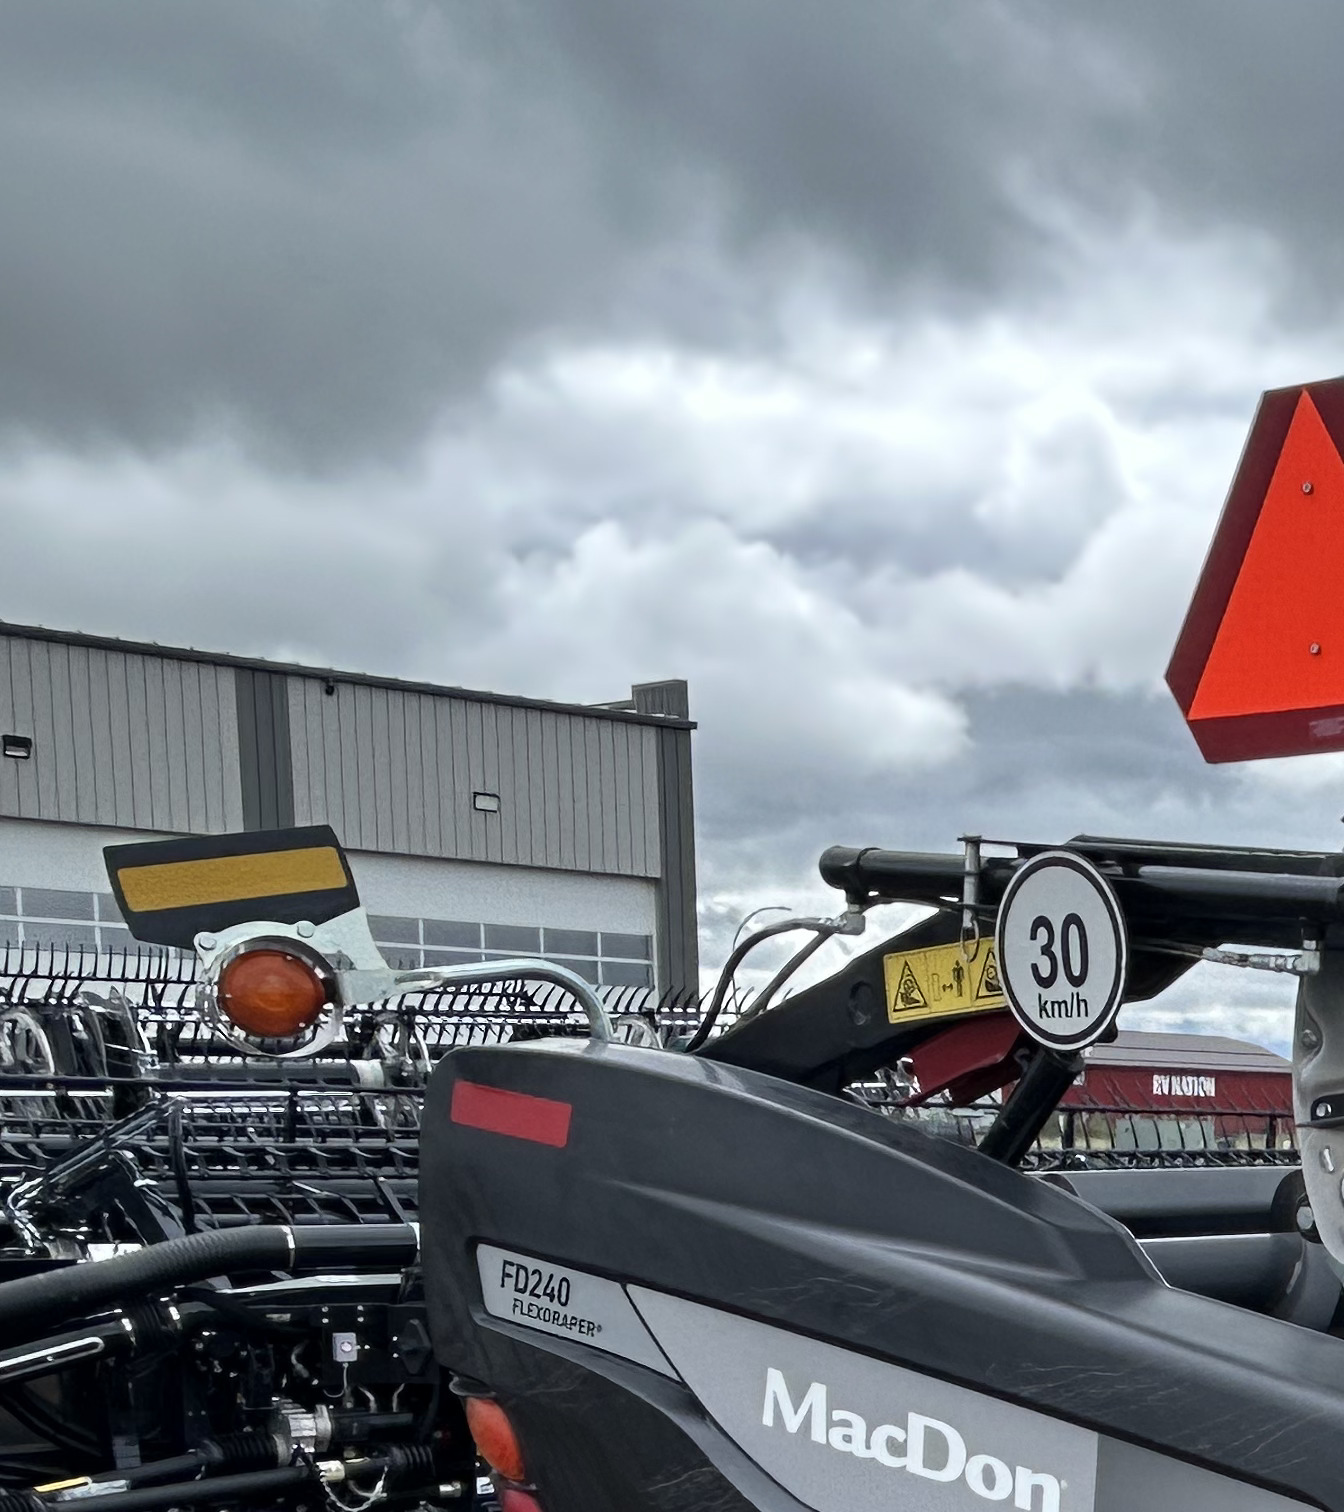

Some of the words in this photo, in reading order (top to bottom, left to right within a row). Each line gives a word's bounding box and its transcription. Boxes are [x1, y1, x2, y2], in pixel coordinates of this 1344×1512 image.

[1029, 912, 1089, 989] 30
[1038, 991, 1089, 1019] km/h
[500, 1259, 571, 1307] FD240
